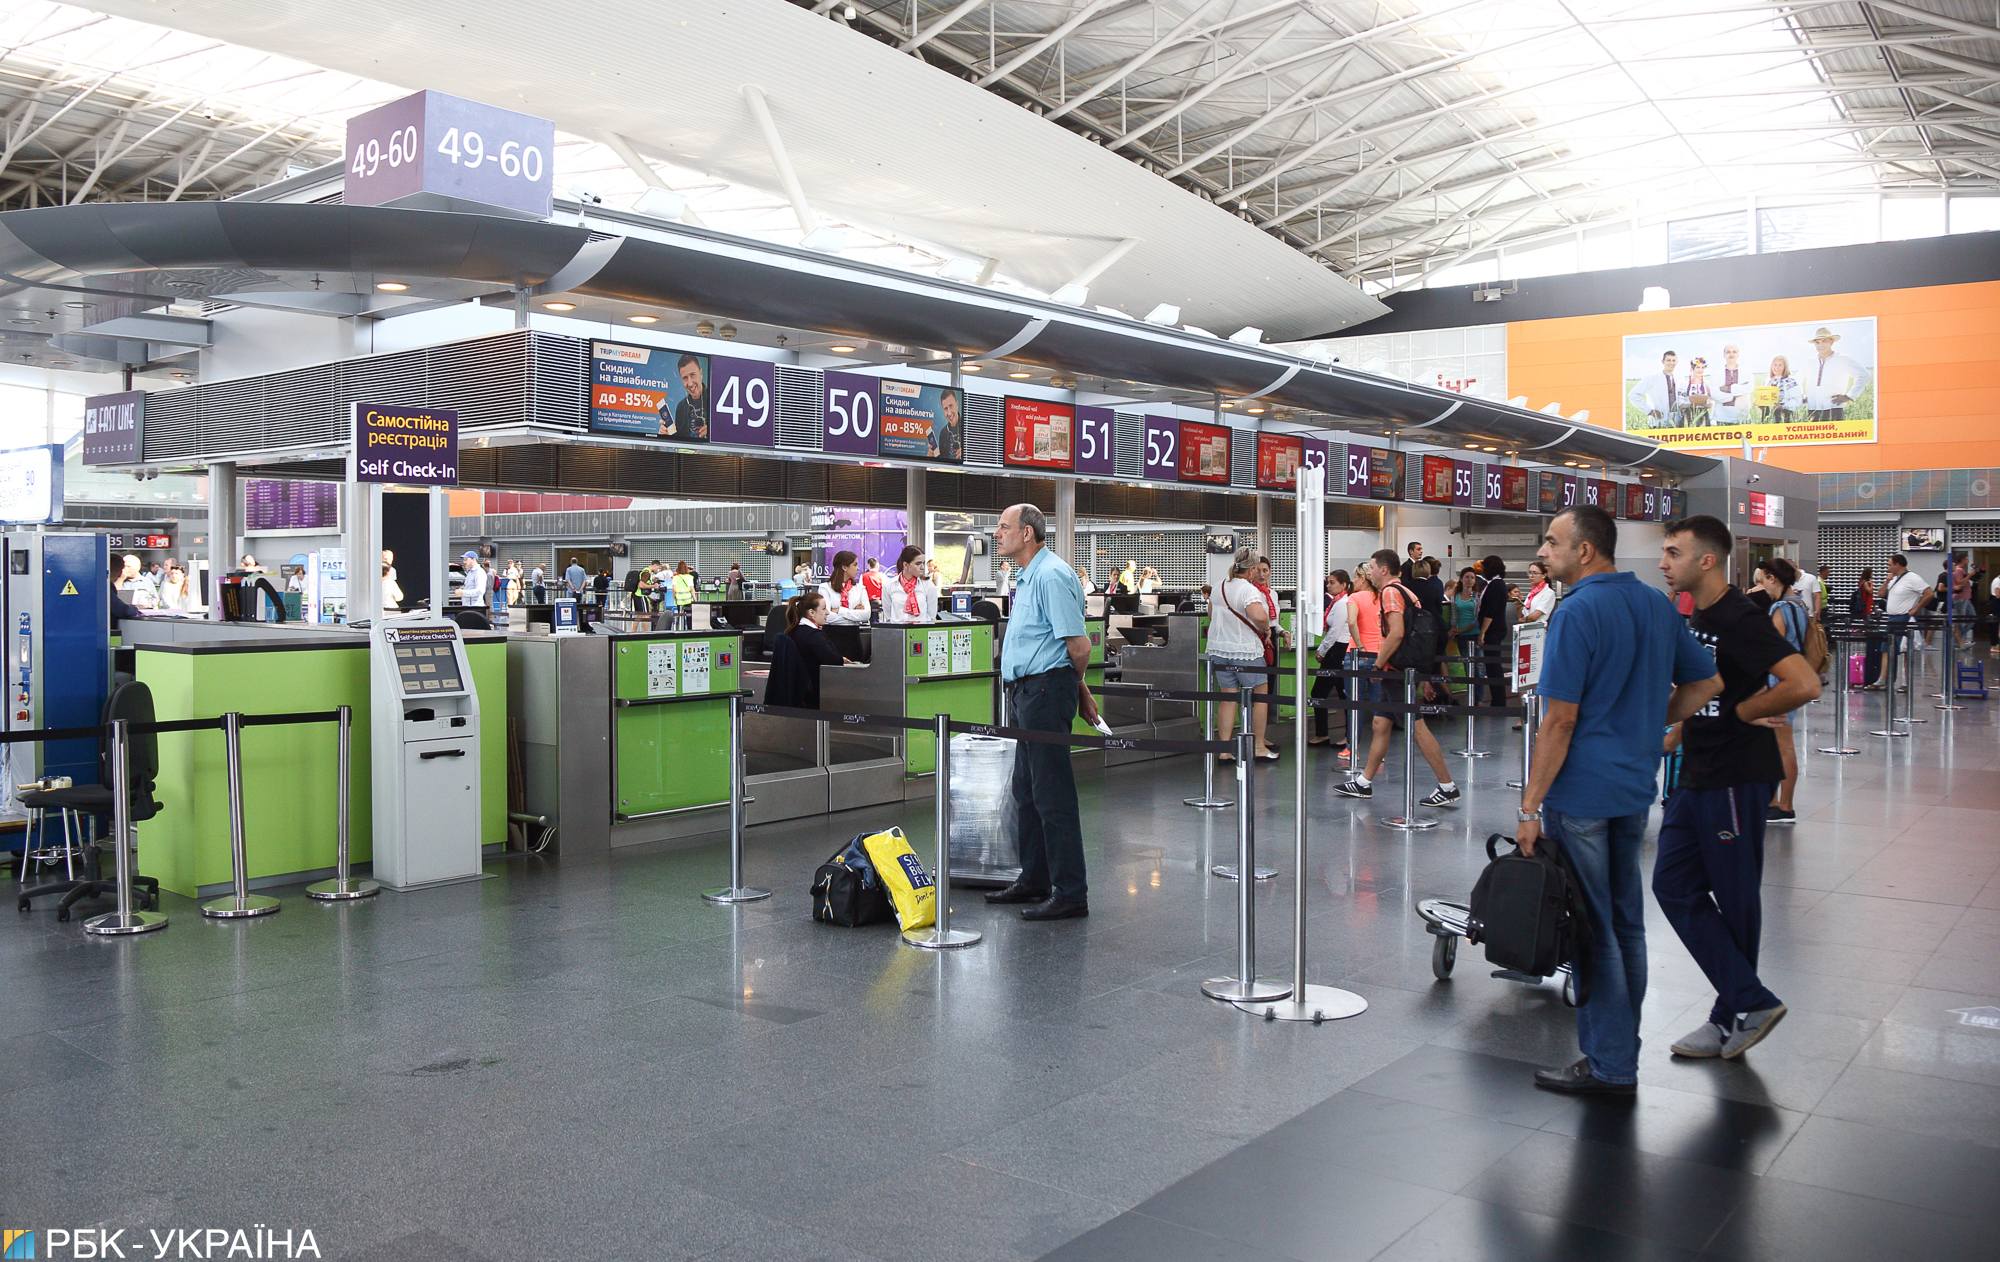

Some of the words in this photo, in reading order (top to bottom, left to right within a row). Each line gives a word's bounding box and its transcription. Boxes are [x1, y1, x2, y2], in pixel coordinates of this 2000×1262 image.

[352, 125, 418, 178] 49-60
[437, 127, 543, 182] 49-60
[600, 348, 641, 359] TRIPMYDREAM
[600, 362, 634, 375] Скидки
[600, 374, 611, 382] на
[613, 375, 668, 389] авиабилеты
[599, 393, 617, 405] до
[619, 392, 653, 408] -85%
[715, 375, 770, 428] 49
[885, 396, 910, 407] Скидки
[98, 405, 117, 433] FAST
[118, 403, 135, 431] LINE
[366, 411, 449, 431] Самостійна
[828, 388, 874, 438] 50
[885, 423, 898, 433] до
[900, 422, 924, 435] -85%
[1745, 431, 1753, 439] 8
[1772, 430, 1868, 441] АВТОМАТИЗОВАНИЙ!
[1786, 424, 1838, 432] УСПІШНИЙ,
[368, 432, 448, 450] реєстрація
[1081, 419, 1109, 460] 51
[1147, 428, 1175, 467] 52
[360, 459, 389, 475] Self
[393, 460, 455, 478] Check-In
[1349, 455, 1368, 486] 54
[1455, 469, 1471, 496] 55
[1486, 474, 1500, 500] 56
[1564, 483, 1576, 506] 57
[1587, 486, 1598, 505] 58
[1645, 493, 1654, 513] 59
[1662, 495, 1671, 515] 60
[110, 536, 122, 546] 35
[134, 536, 147, 546] 36
[322, 561, 343, 570] FAST
